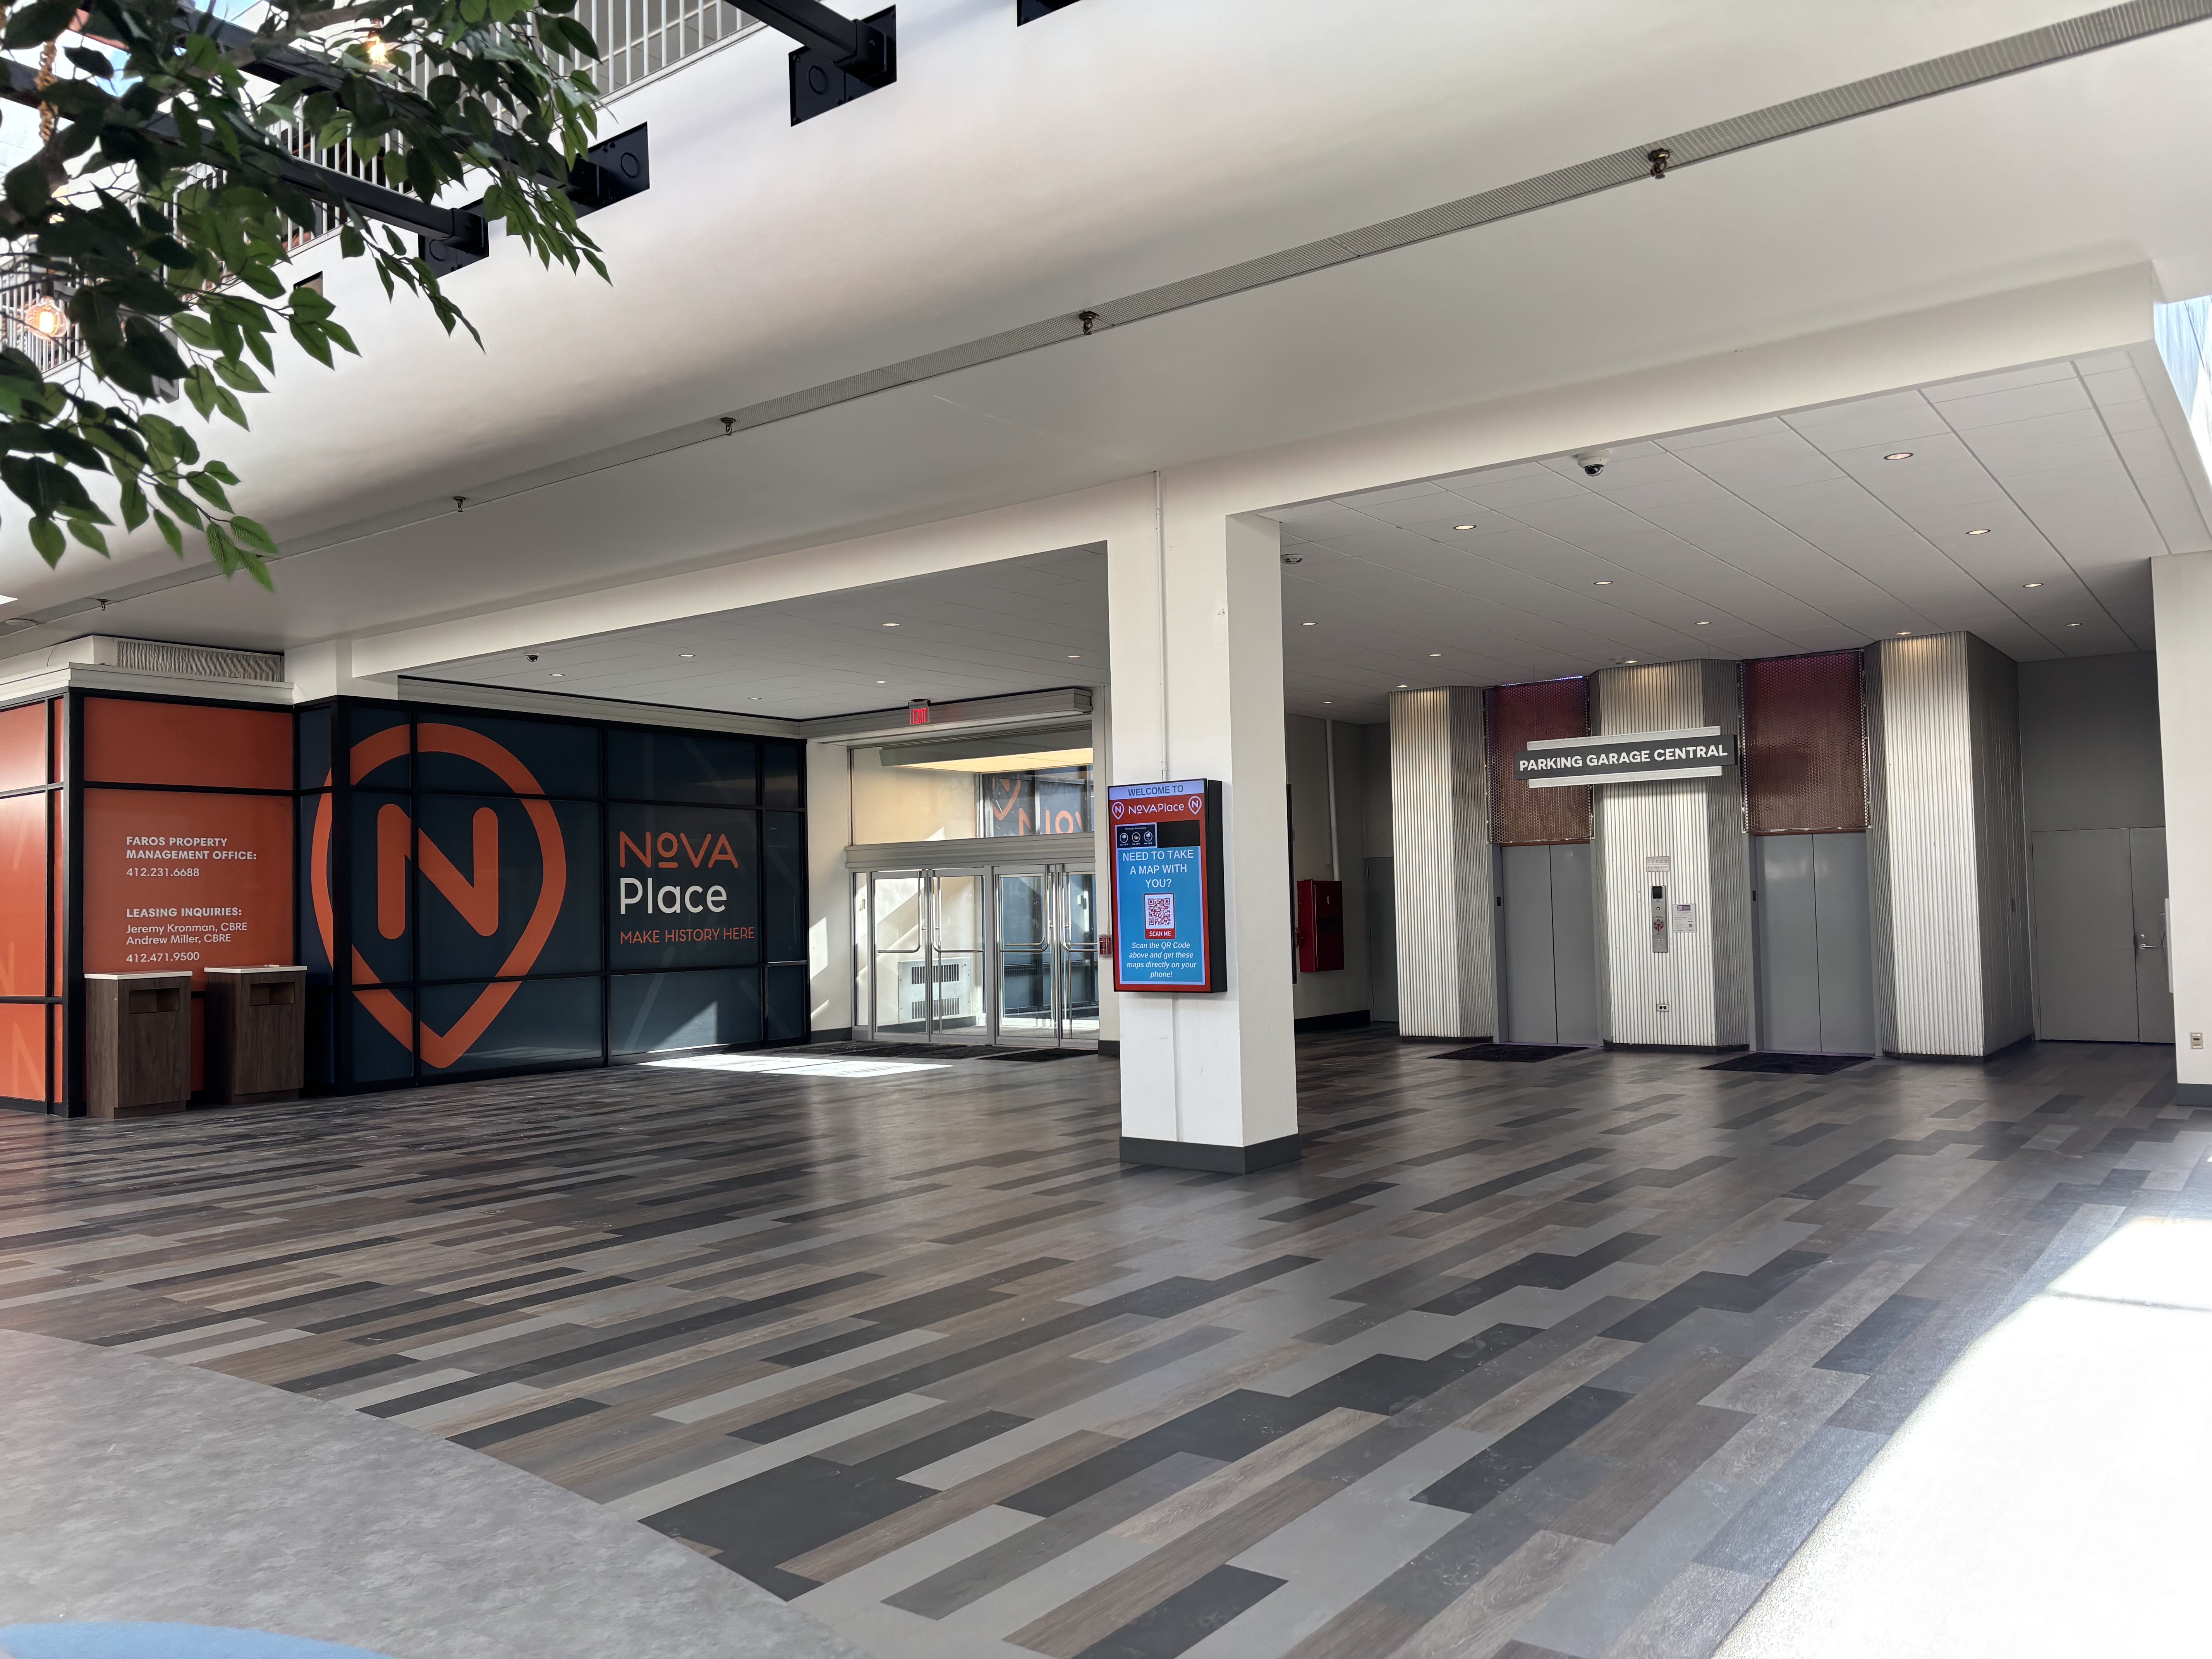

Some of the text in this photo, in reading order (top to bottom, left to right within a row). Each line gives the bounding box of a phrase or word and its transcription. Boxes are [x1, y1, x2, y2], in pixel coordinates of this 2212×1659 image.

[913, 708, 927, 725] EXIT
[1520, 744, 1728, 771] PARKING GARAGE CENTRAL
[1128, 785, 1183, 796] WELCOME TO
[126, 836, 227, 847] FAROS PROPERTY
[126, 850, 256, 860] MANAGEMENT OFFICE:
[1123, 850, 1194, 861] NEED TO TAKE
[126, 868, 199, 877] 412.231.6688
[378, 804, 499, 939] N
[1130, 864, 1187, 875] A MAP WITH
[1145, 879, 1172, 888] YOU?
[620, 878, 727, 915] Place
[127, 907, 242, 917] LEASING INQUIRIES:
[126, 922, 247, 934] Jeremy Kronman, CBRE
[126, 934, 231, 945] Andrew Miller, CBRE
[620, 927, 754, 944] MAKE HISTORY HERE
[126, 952, 200, 963] 412.471.9500
[1146, 961, 1170, 969] directly
[1150, 971, 1173, 979] phone!
